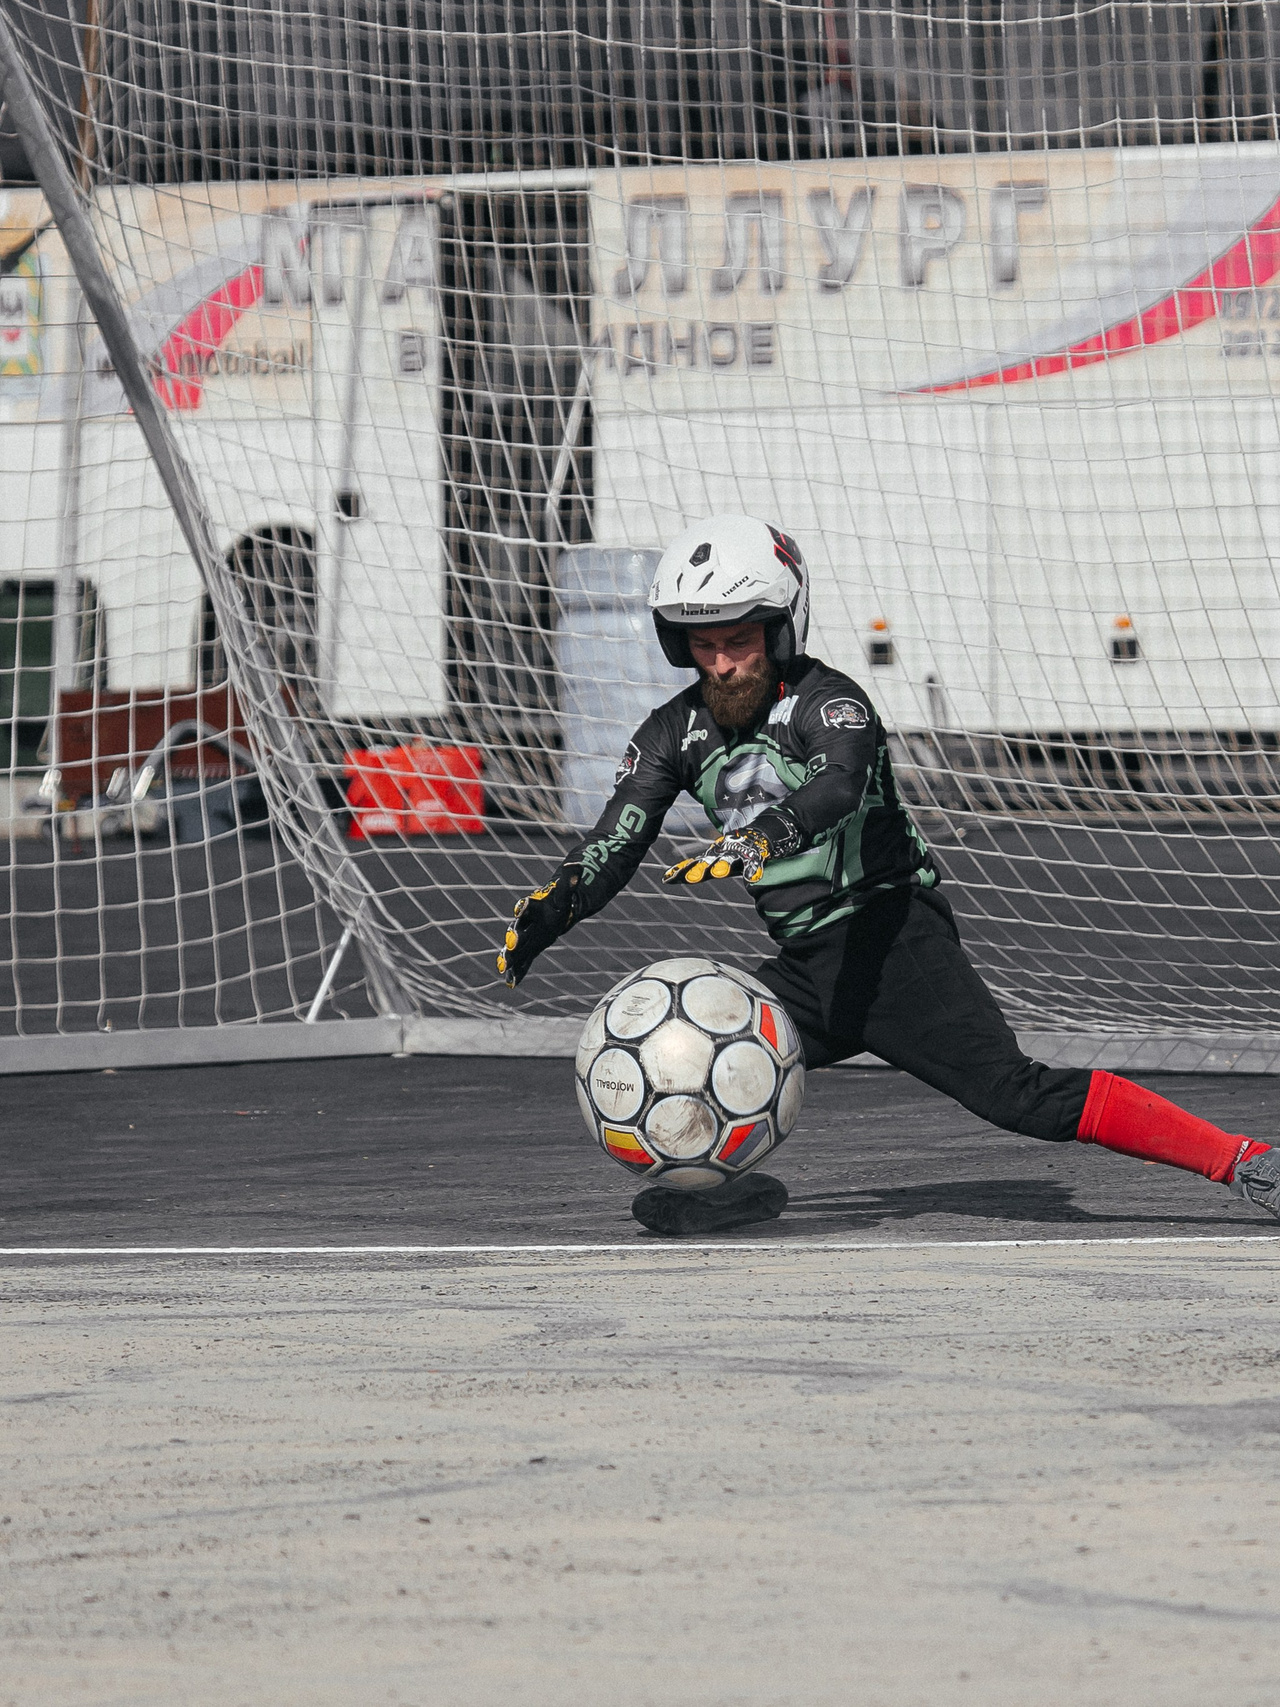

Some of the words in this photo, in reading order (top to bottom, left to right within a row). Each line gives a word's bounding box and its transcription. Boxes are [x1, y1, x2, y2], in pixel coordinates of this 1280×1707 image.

[722, 575, 749, 597] hebo
[681, 608, 720, 616] hebo
[596, 1079, 634, 1092] MOTOBALL
